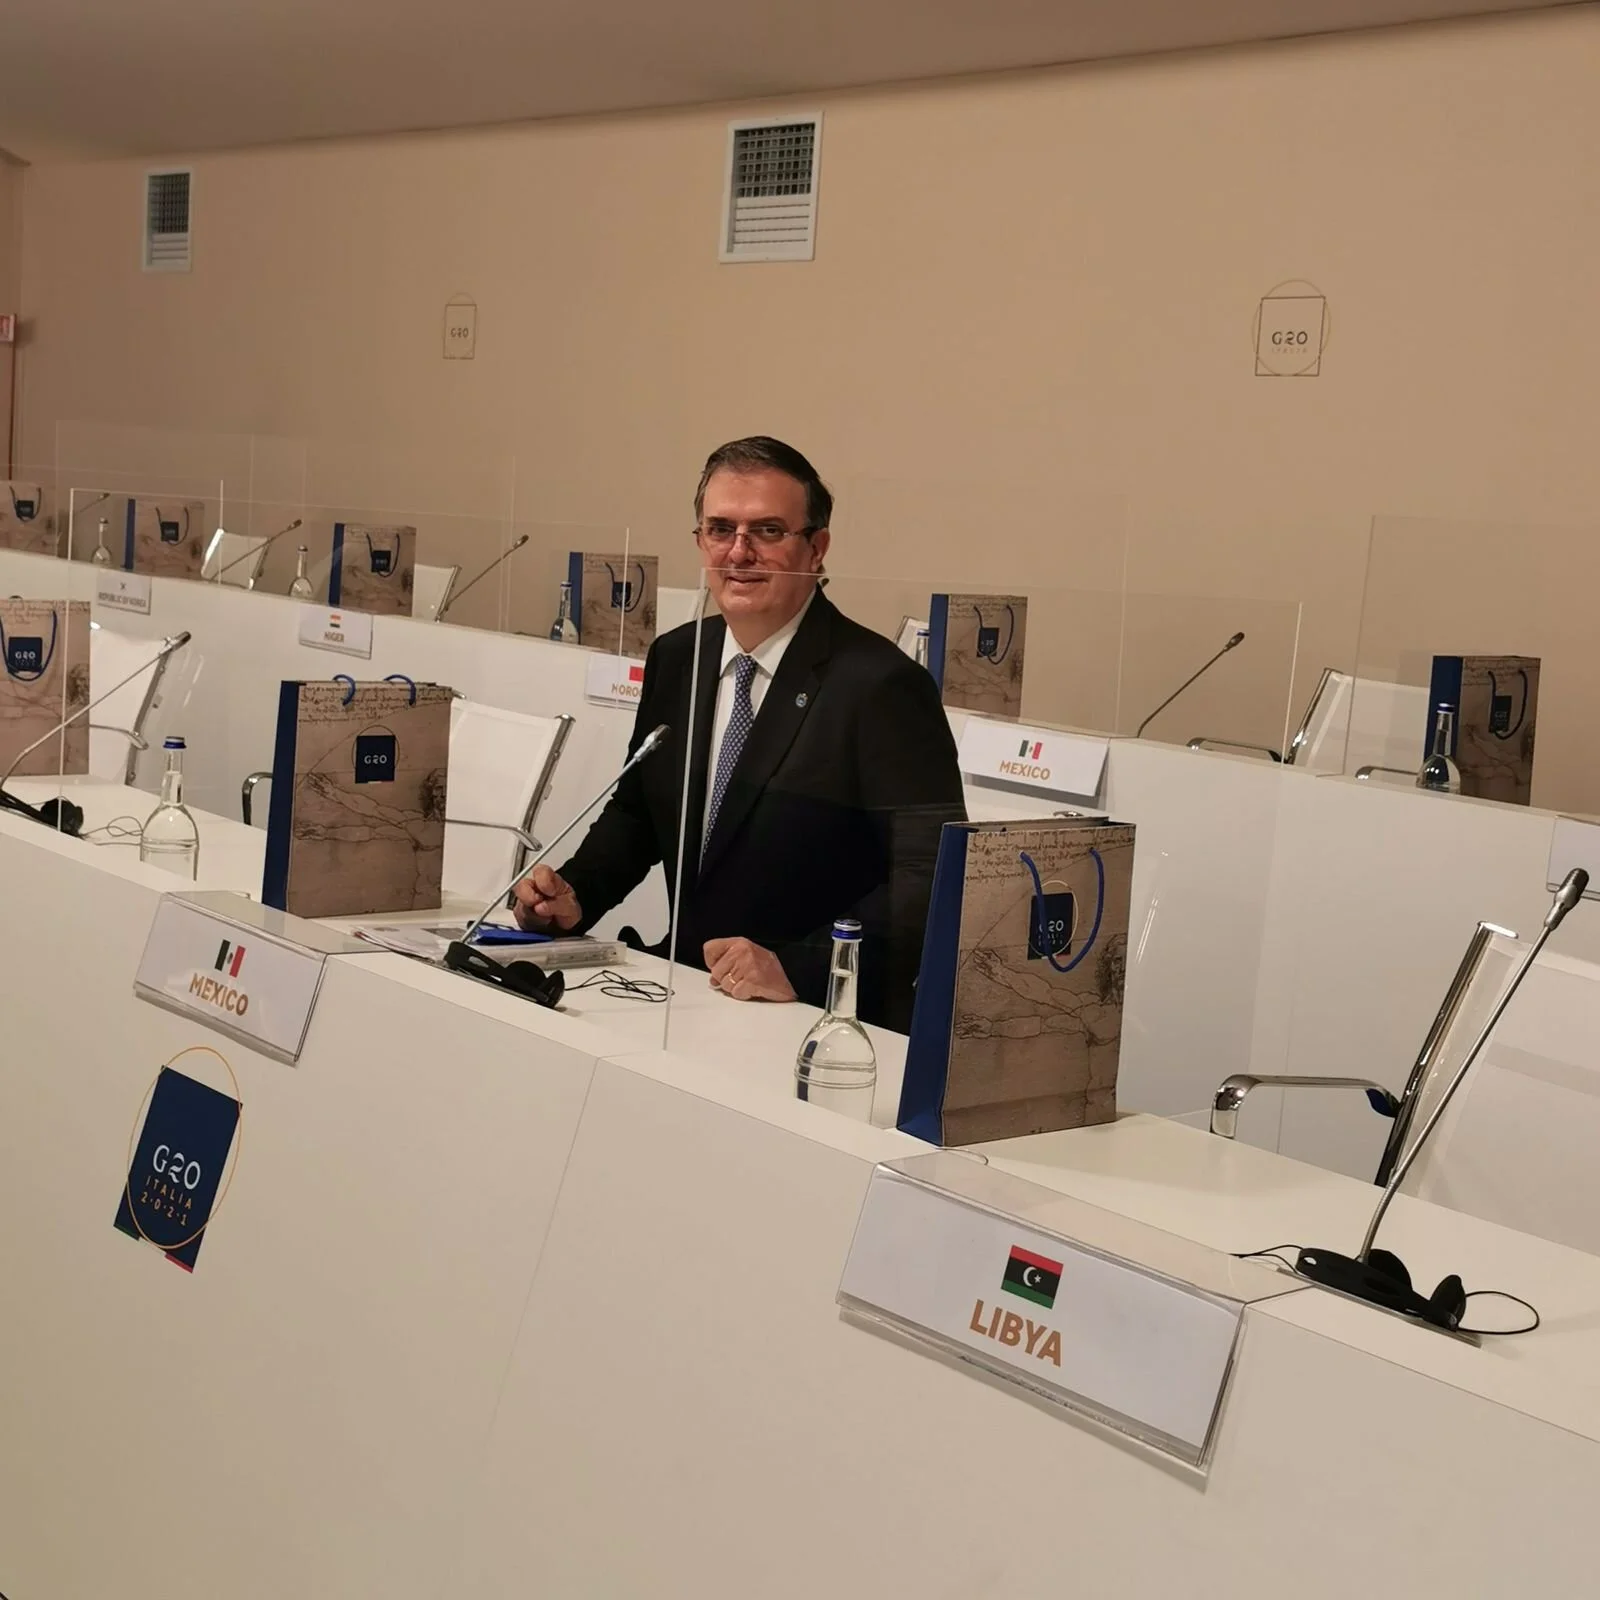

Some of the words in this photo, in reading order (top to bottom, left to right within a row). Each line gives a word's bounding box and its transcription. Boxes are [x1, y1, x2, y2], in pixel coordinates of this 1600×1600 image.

[1271, 331, 1308, 346] G20
[364, 754, 388, 765] G20
[999, 760, 1051, 781] MEXICO
[189, 972, 249, 1017] MEXICO
[153, 1144, 201, 1190] G20
[145, 1175, 193, 1210] ITALIA
[969, 1298, 1062, 1369] LIBYA
